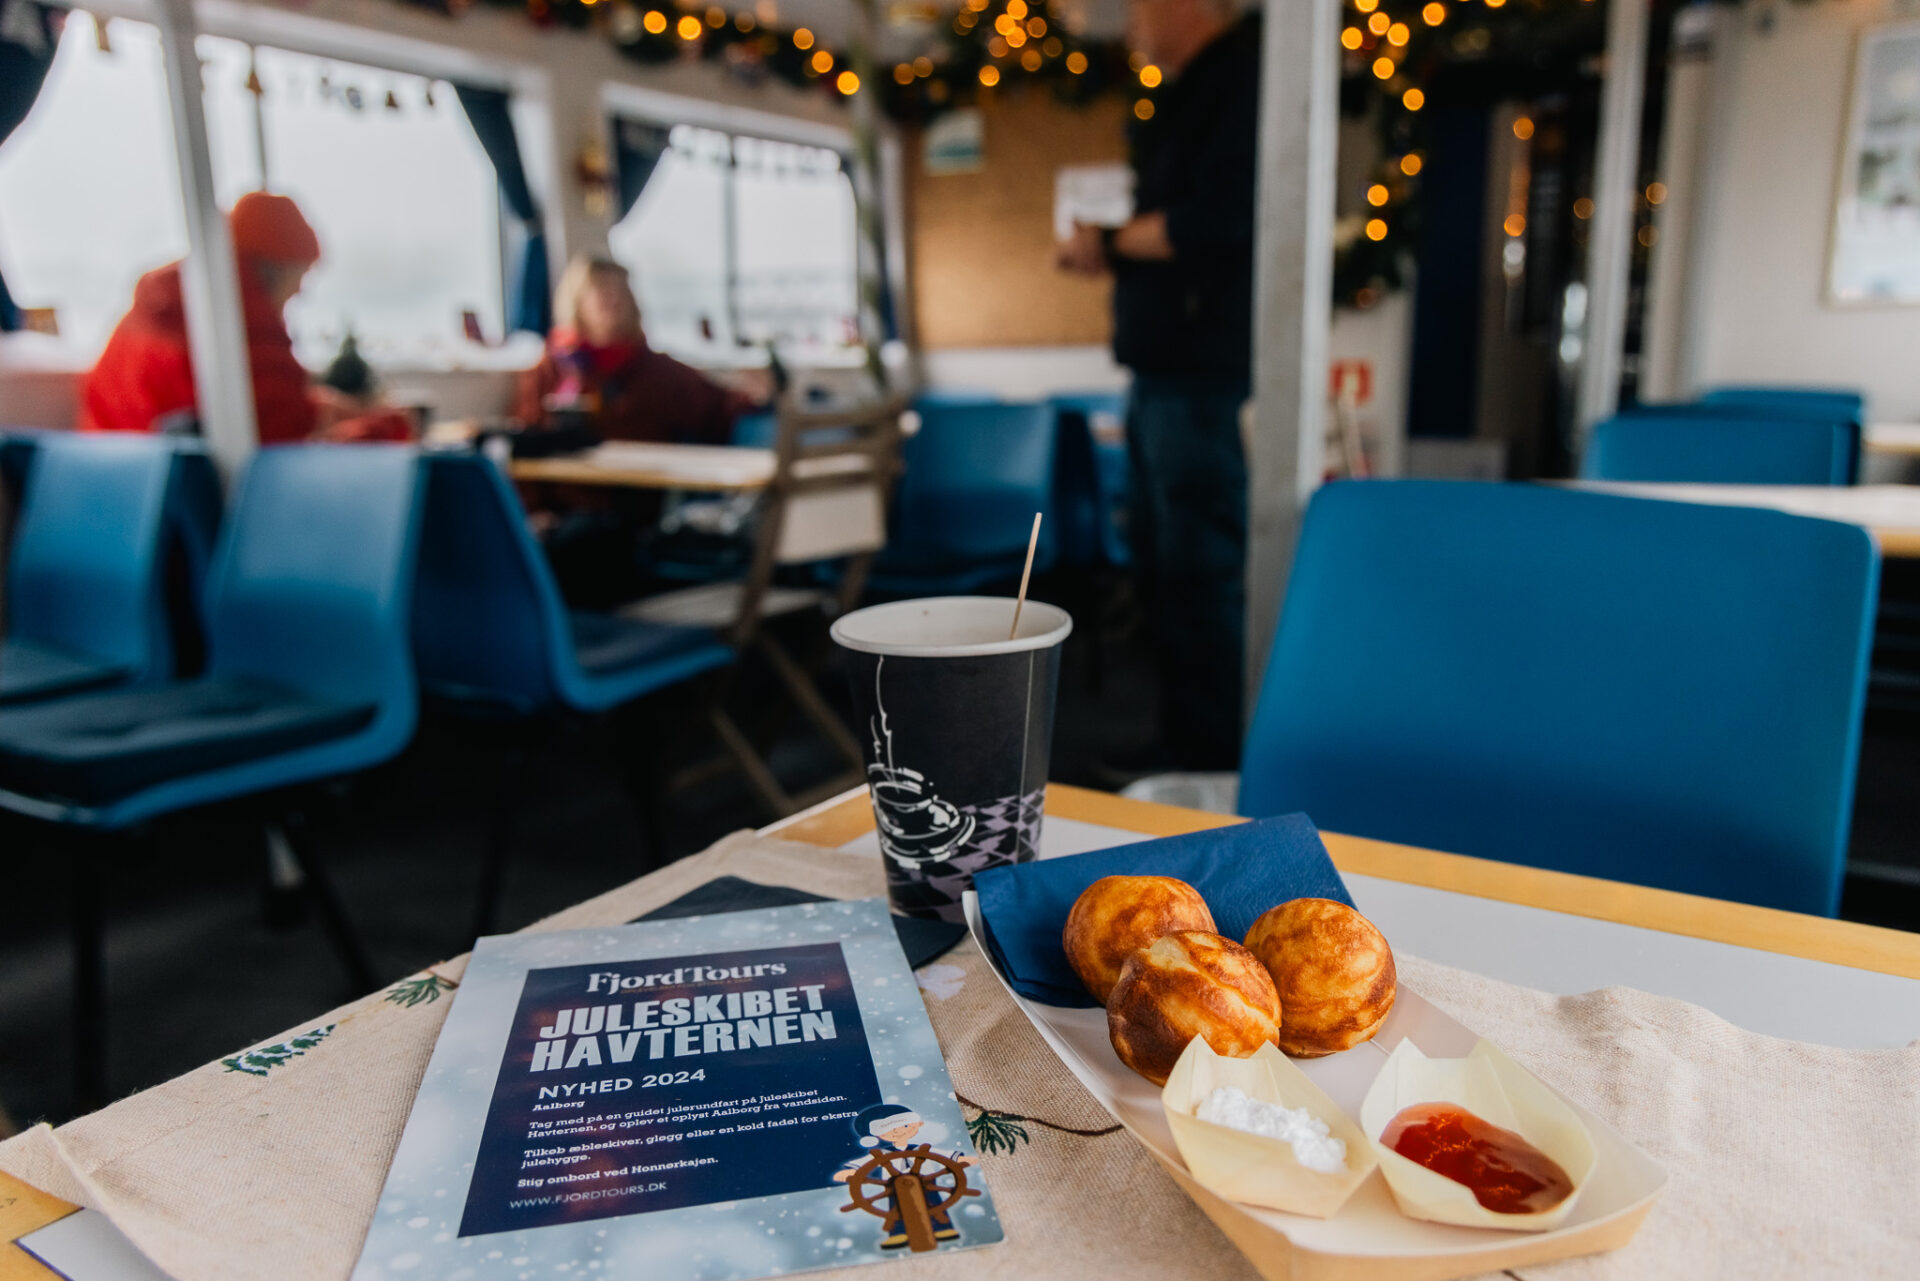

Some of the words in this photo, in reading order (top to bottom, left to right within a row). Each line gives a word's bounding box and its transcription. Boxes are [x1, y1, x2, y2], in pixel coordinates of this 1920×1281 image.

[539, 984, 826, 1039] JULESKIBET
[529, 1010, 838, 1073] HAVTERNEN
[538, 1077, 634, 1100] NYHED
[641, 1068, 707, 1088] 2024
[527, 1124, 597, 1138] Havternen,
[600, 1120, 617, 1131] og
[619, 1116, 654, 1130] oplev
[657, 1115, 670, 1124] et
[671, 1108, 710, 1124] oplyst
[711, 1104, 762, 1119] Aalborg
[763, 1101, 781, 1113] fra
[783, 1095, 847, 1108] vandsiden.
[529, 1119, 554, 1130] Tag
[556, 1115, 585, 1127] med
[587, 1111, 604, 1124] på
[606, 1111, 622, 1121] en
[624, 1106, 665, 1120] guidet
[667, 1099, 739, 1115] julerundfart
[741, 1095, 758, 1107] på
[759, 1089, 818, 1104] Juleskibet
[532, 1100, 586, 1112] Aalborg
[524, 1146, 566, 1158] Tilkøb
[568, 1136, 644, 1152] æbleskiver,
[646, 1131, 684, 1146] gløgg
[686, 1127, 716, 1139] eller
[718, 1124, 735, 1135] en
[737, 1120, 765, 1133] kold
[801, 1113, 819, 1124] for
[821, 1108, 860, 1122] ekstra
[516, 1176, 546, 1189] Stig
[547, 1169, 601, 1186] ombord
[603, 1166, 629, 1178] ved
[631, 1156, 719, 1173] Honnørkajen.
[521, 1154, 591, 1169] julehygge.
[509, 1182, 667, 1209] WWW.FJORDTOURS.DK
